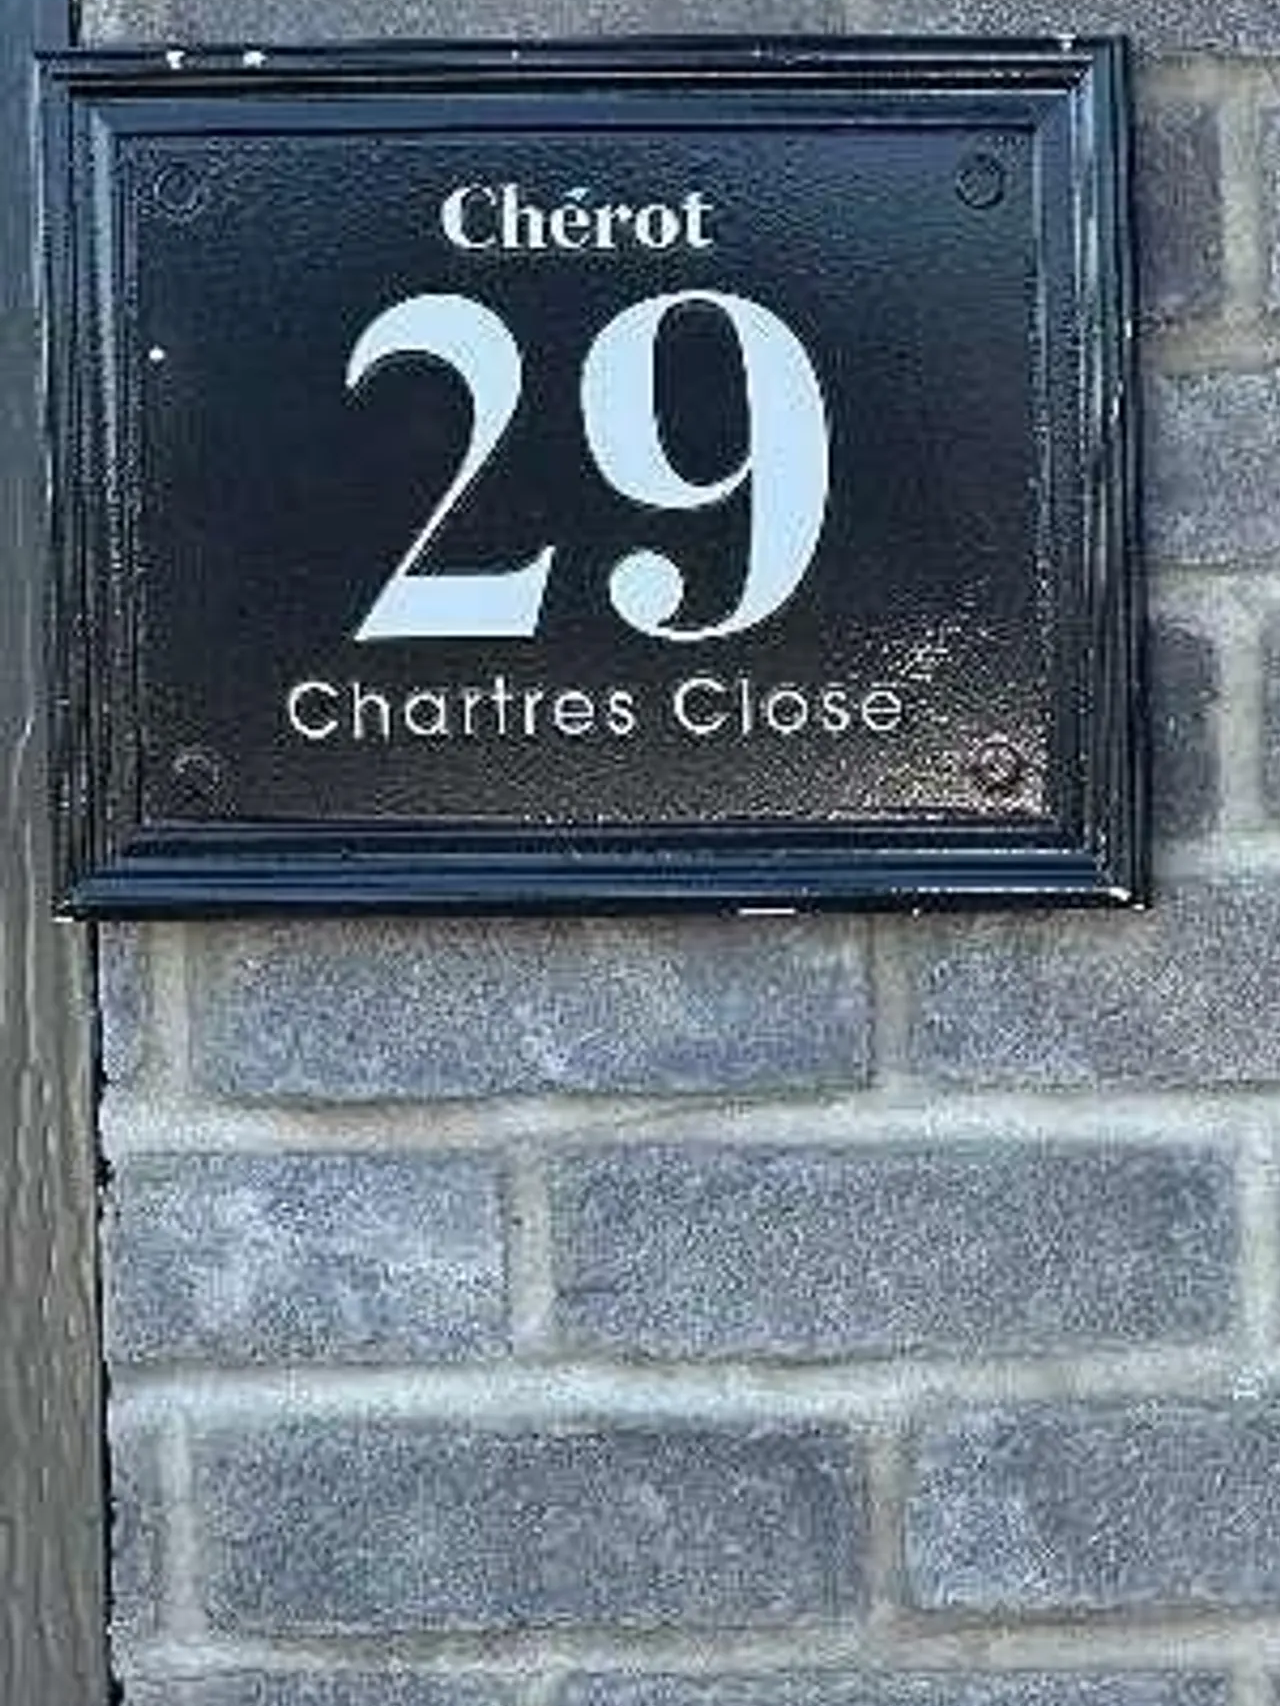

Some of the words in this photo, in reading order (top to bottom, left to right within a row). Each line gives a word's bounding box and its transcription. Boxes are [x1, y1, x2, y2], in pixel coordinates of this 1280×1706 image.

[440, 182, 716, 250] Chérot
[344, 290, 830, 642] 29
[287, 677, 637, 741] Chartres
[672, 677, 904, 736] Close
